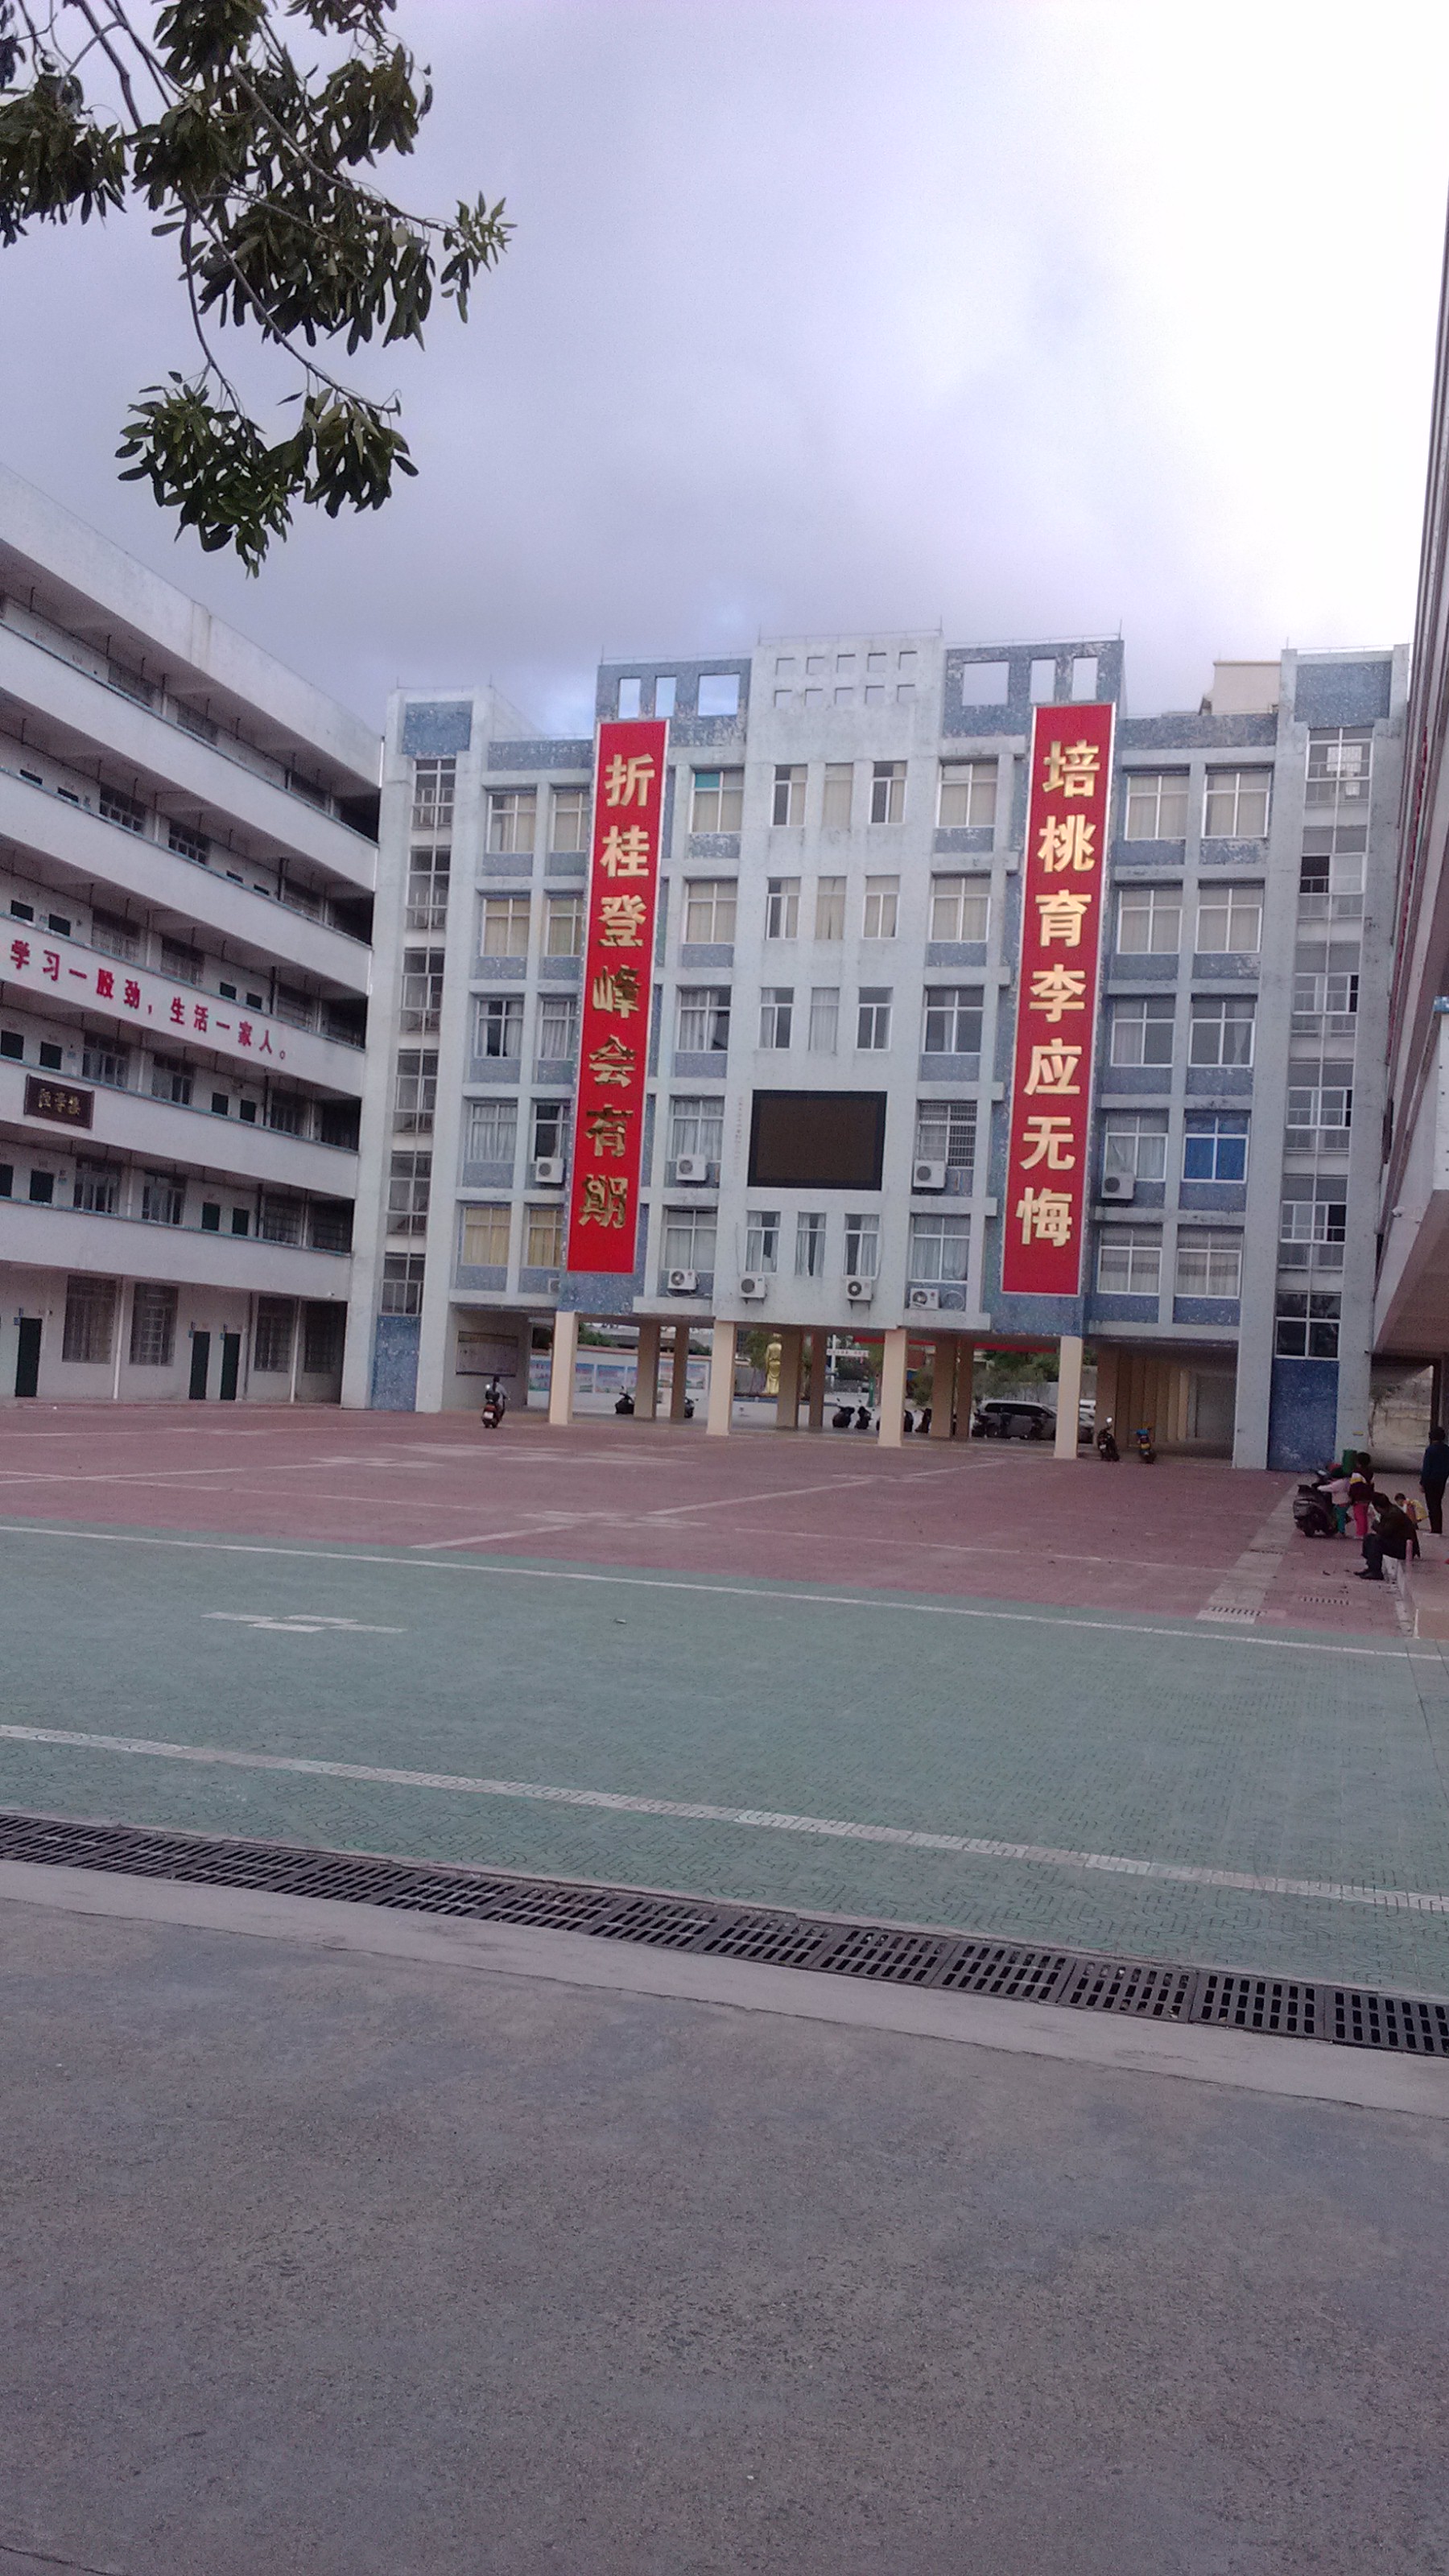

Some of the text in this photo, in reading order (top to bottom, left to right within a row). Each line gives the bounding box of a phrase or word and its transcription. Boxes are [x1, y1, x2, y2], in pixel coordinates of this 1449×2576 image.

[579, 753, 655, 1228] 折桂登峰会有期
[1016, 739, 1100, 1248] 培桃育李应无悔
